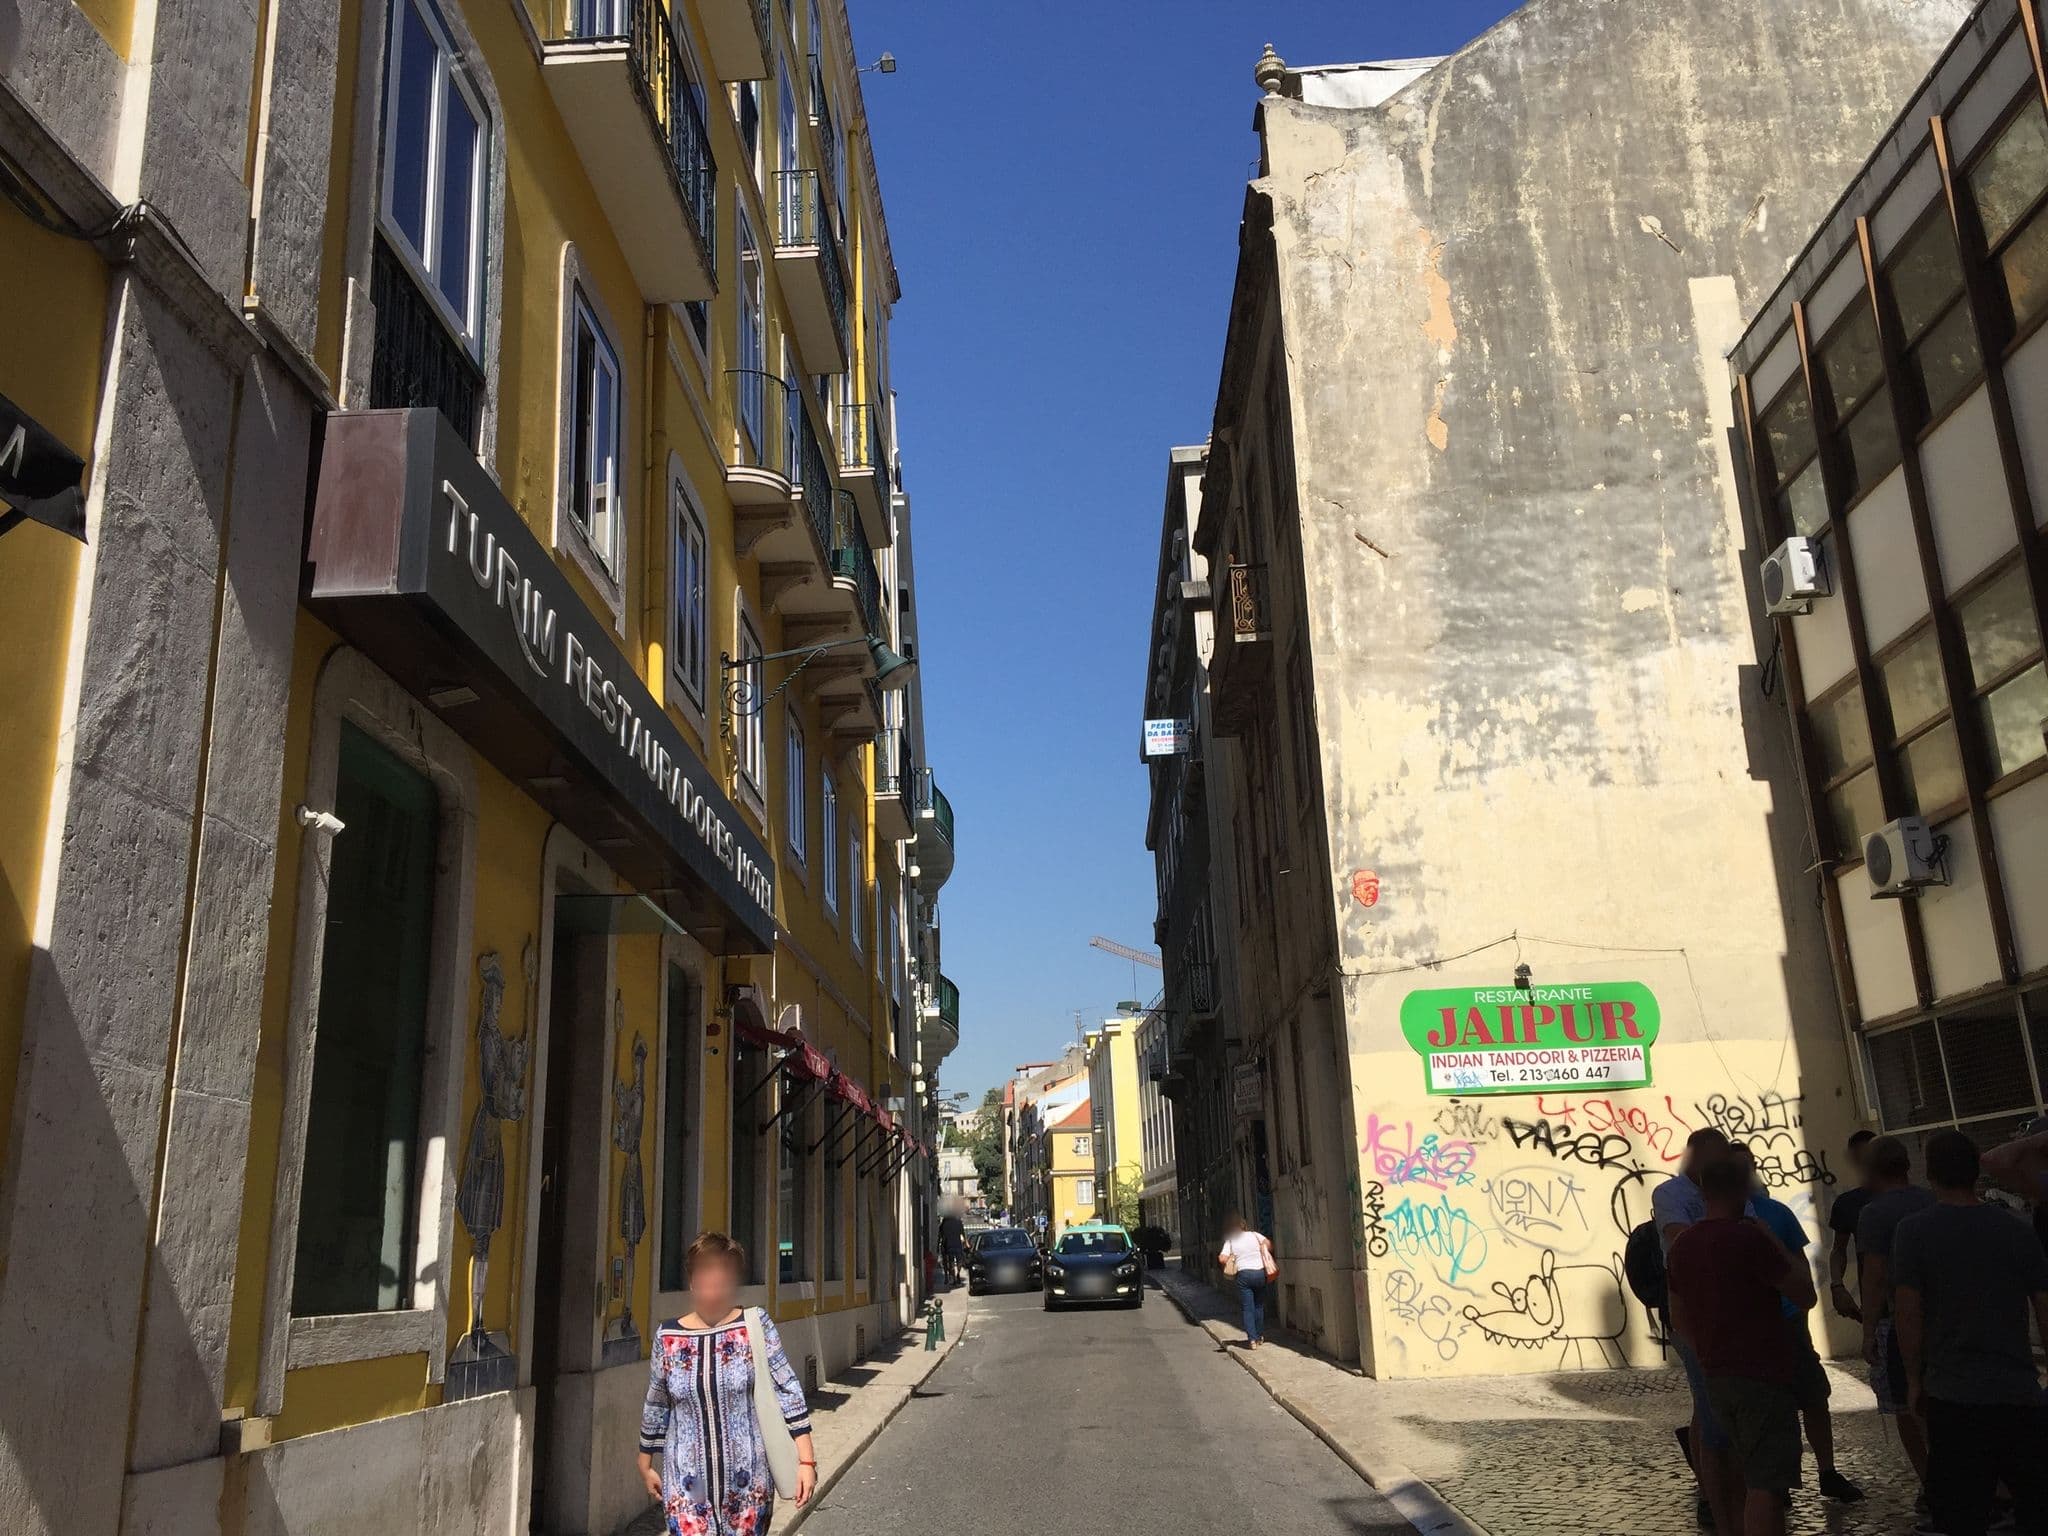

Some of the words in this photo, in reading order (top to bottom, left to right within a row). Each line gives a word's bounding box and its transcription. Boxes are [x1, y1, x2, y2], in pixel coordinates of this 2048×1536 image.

[443, 479, 557, 678] TURIM
[565, 632, 734, 871] RESTAURADORES
[737, 846, 772, 918] HOTEL
[1474, 987, 1593, 1004] RESTAURANTE
[1427, 1001, 1645, 1048] JAIPUR
[1431, 1053, 1483, 1069] INDIAN
[1489, 1050, 1565, 1067] TANDOORI
[1568, 1051, 1579, 1063] &
[1581, 1047, 1643, 1063] PIZZERIA
[1489, 1069, 1514, 1082] Tel.
[1519, 1068, 1544, 1081] 213
[1552, 1067, 1580, 1080] 460
[1585, 1066, 1611, 1079] 447
